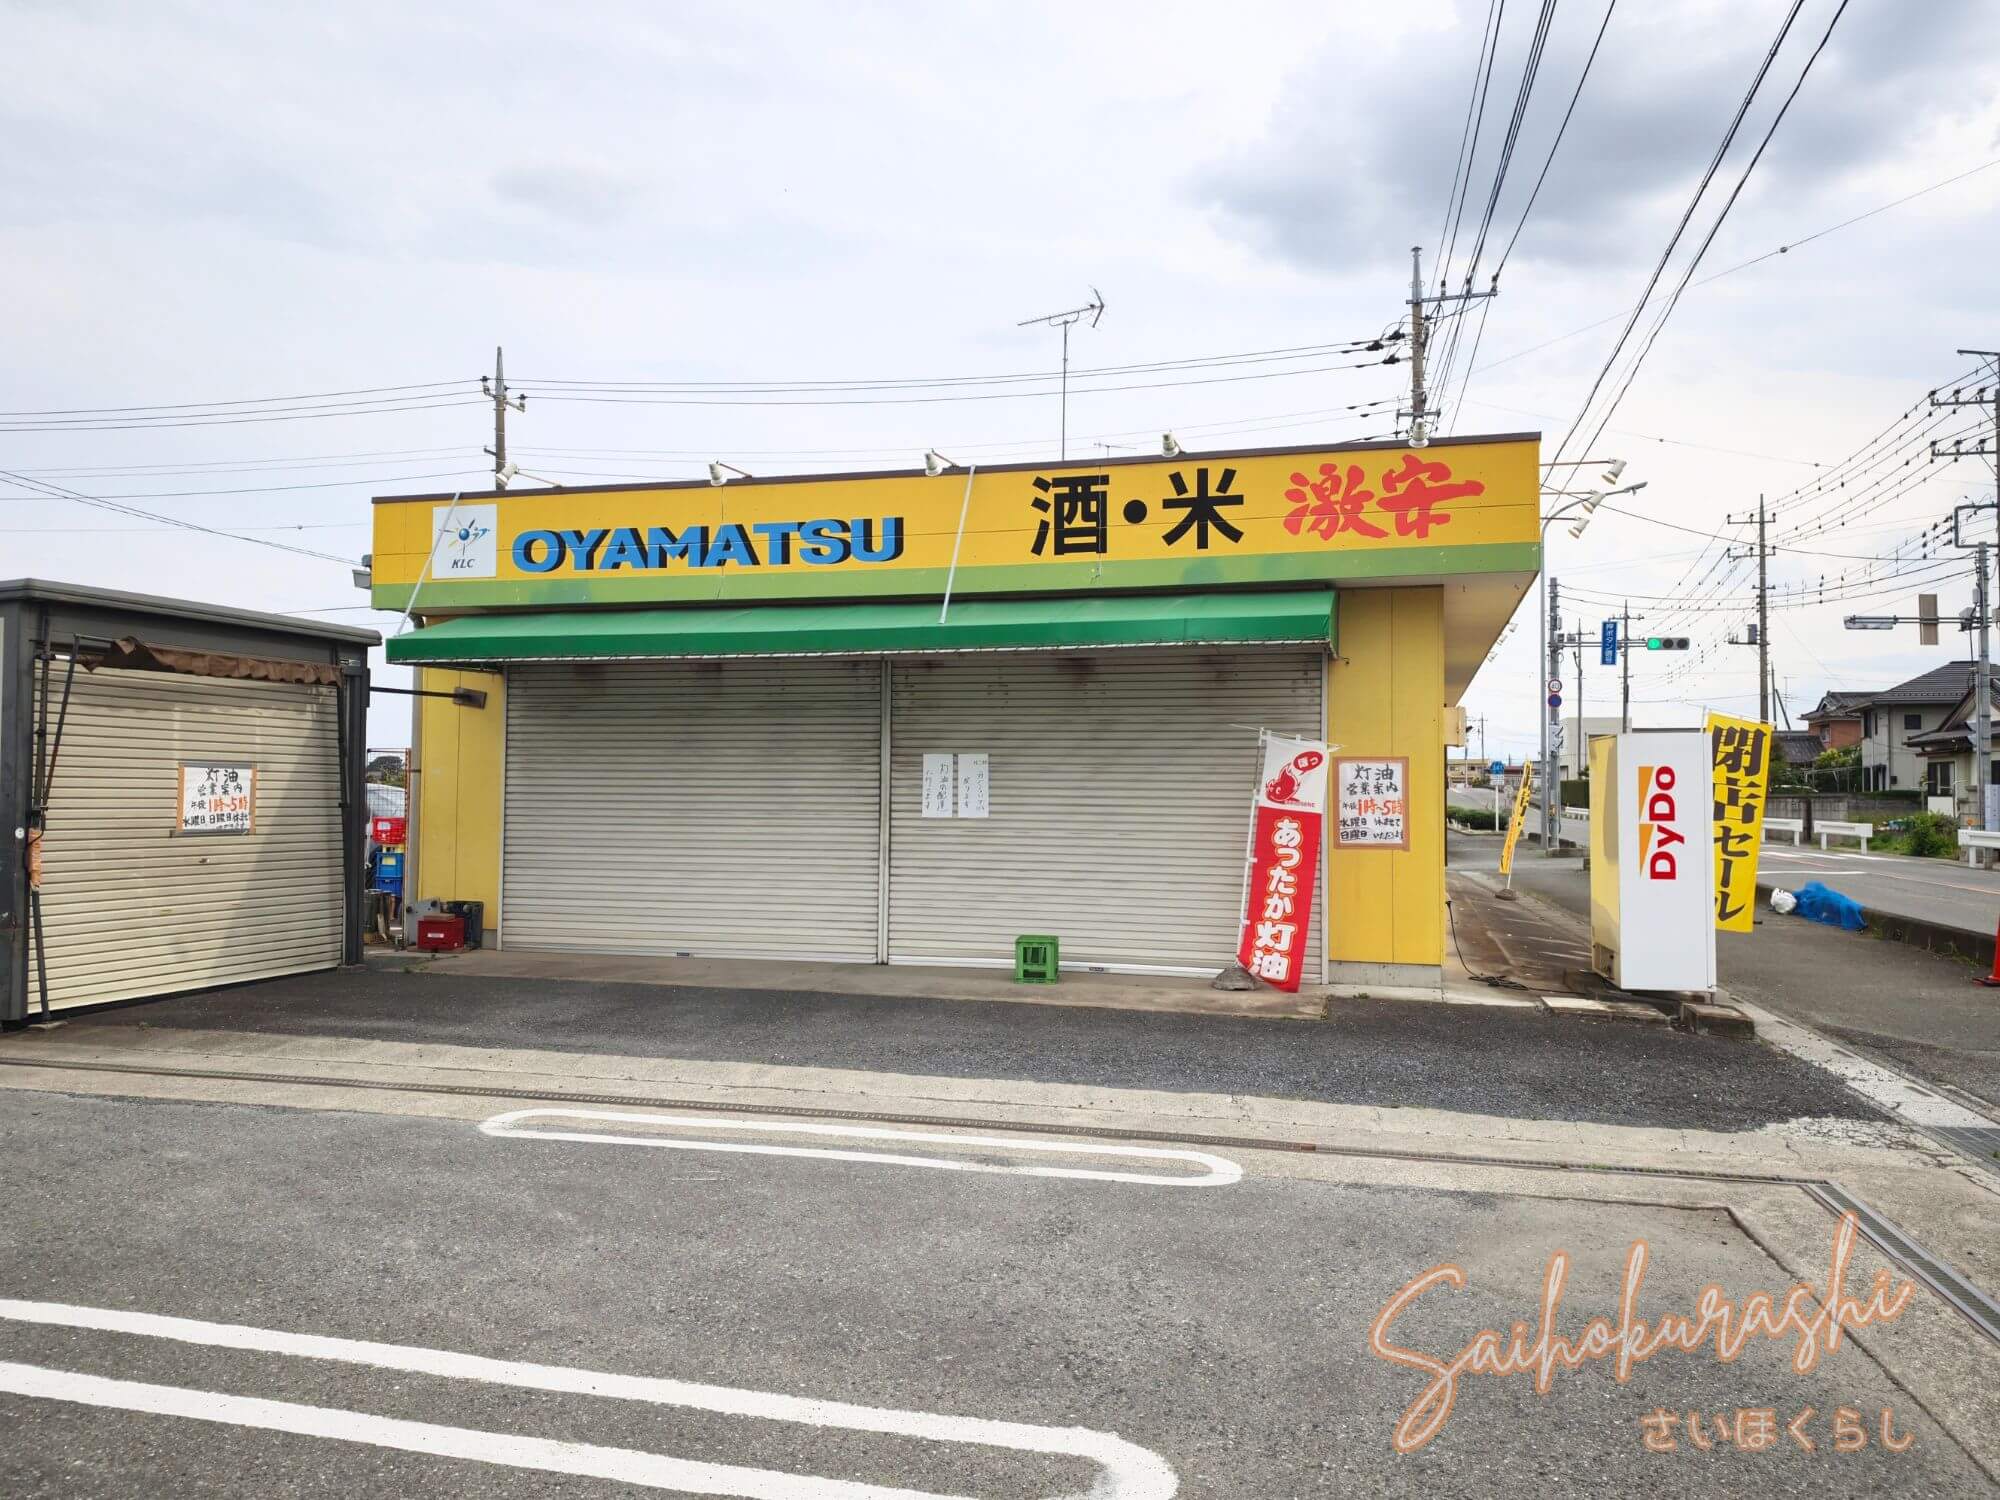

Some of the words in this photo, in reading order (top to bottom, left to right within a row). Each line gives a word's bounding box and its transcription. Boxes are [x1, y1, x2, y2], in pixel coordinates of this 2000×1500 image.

[451, 558, 476, 569] KLC
[512, 516, 904, 572] OYAMATSU
[1282, 453, 1486, 541] 激安
[206, 767, 239, 783] 灯油
[1354, 763, 1394, 780] 灯油
[1649, 766, 1685, 880] DyDo
[1712, 725, 1768, 922] 閉店セール
[1252, 818, 1302, 981] あったか灯油
